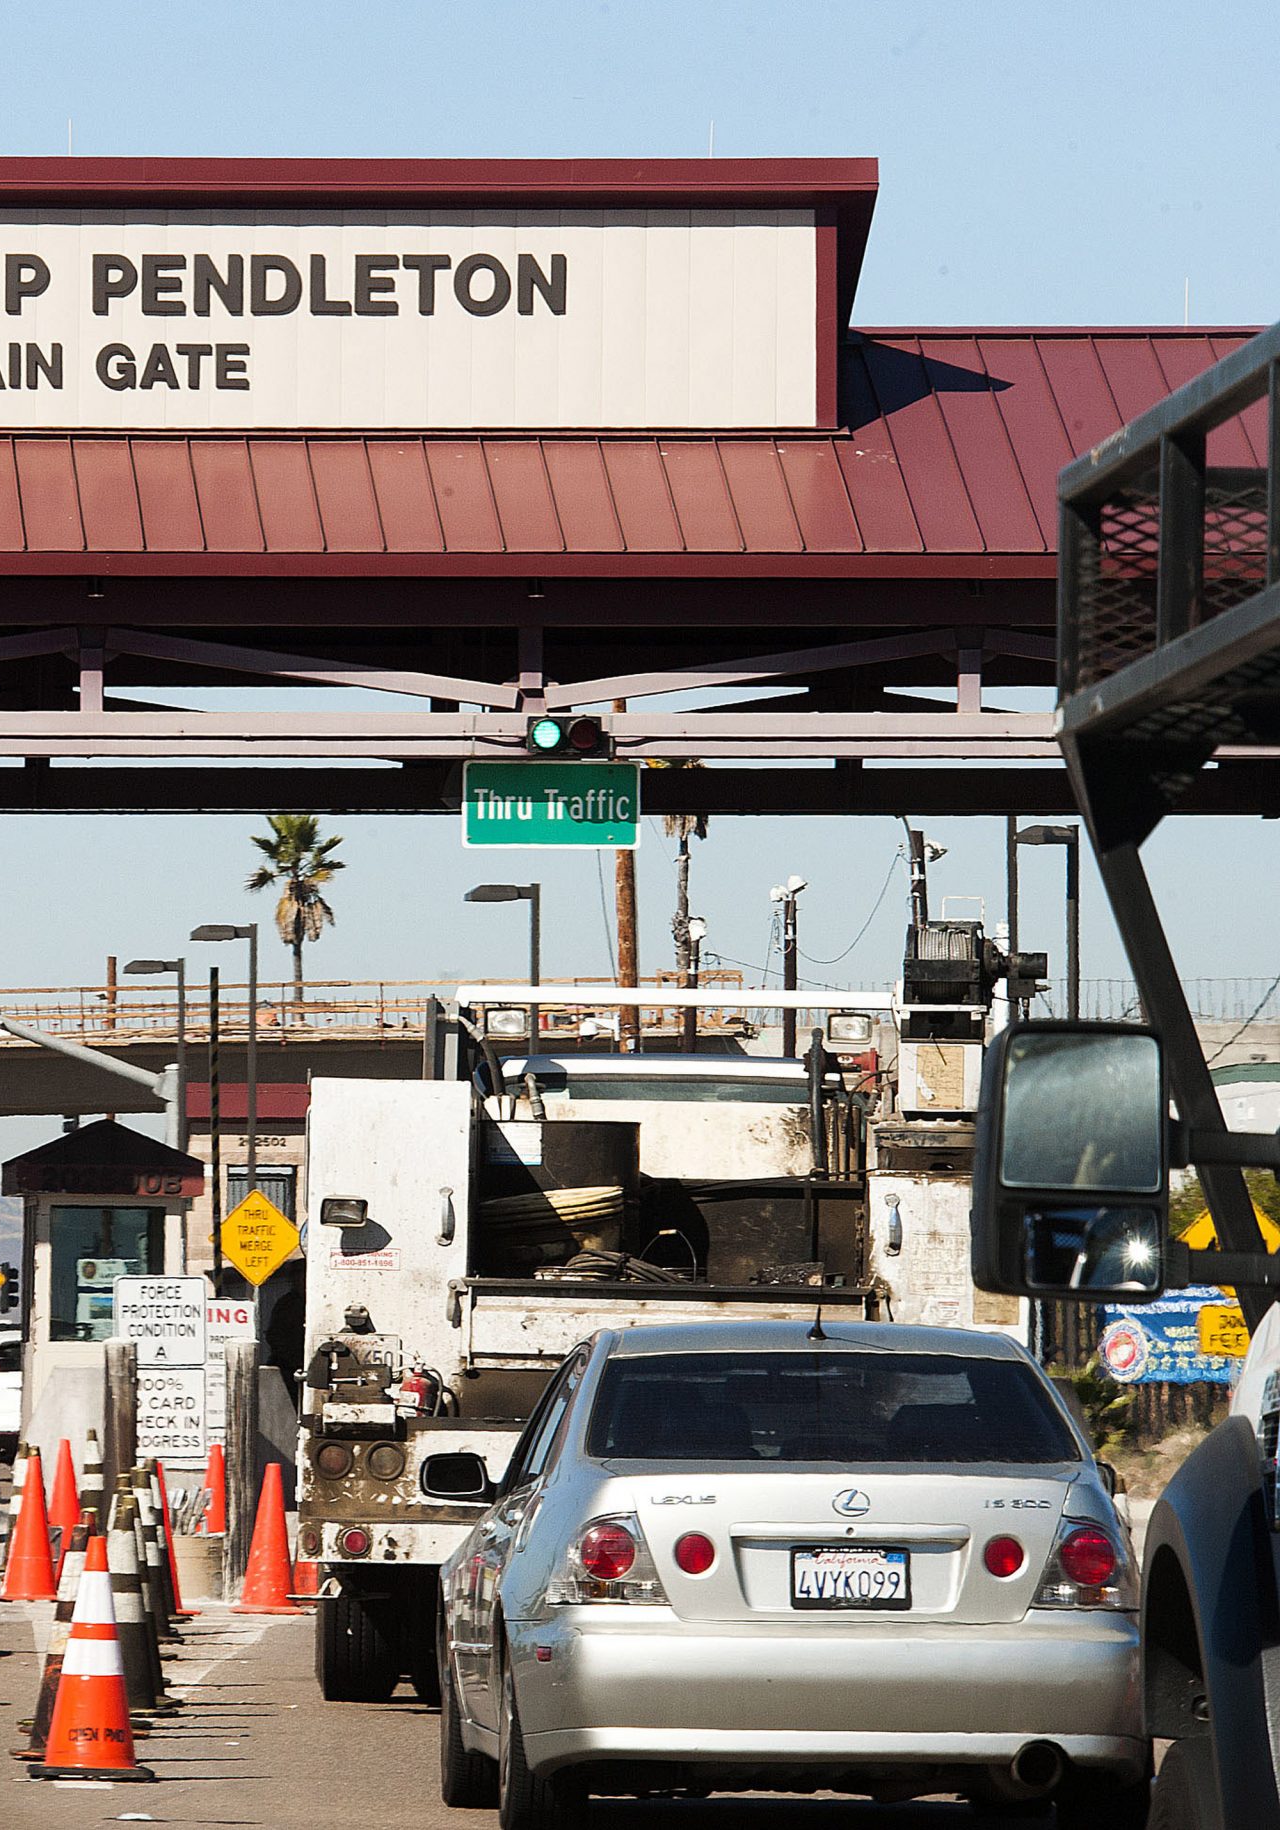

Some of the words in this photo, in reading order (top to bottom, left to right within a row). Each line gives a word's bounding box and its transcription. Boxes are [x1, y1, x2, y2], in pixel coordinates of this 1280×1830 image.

[92, 253, 567, 317] PENDLETON
[95, 342, 250, 391] GATE
[474, 788, 532, 820] Thru
[544, 788, 630, 820] Traffic
[238, 1137, 286, 1147] 22502
[243, 1209, 269, 1221] THRU
[237, 1225, 276, 1236] TRAFFIC
[239, 1240, 273, 1252] MERGE
[245, 1256, 269, 1267] LEFT
[140, 1285, 182, 1299] FORCE
[122, 1304, 201, 1318] PROTECTION
[128, 1323, 196, 1337] CONDITION
[154, 1346, 167, 1359] A
[149, 1397, 196, 1410] CARD
[137, 1416, 178, 1429] HECK
[183, 1416, 200, 1429] IN
[138, 1435, 200, 1448] OGRESS
[651, 1495, 718, 1505] LEXUS
[814, 1552, 880, 1568] California
[798, 1570, 901, 1598] 4VYK099
